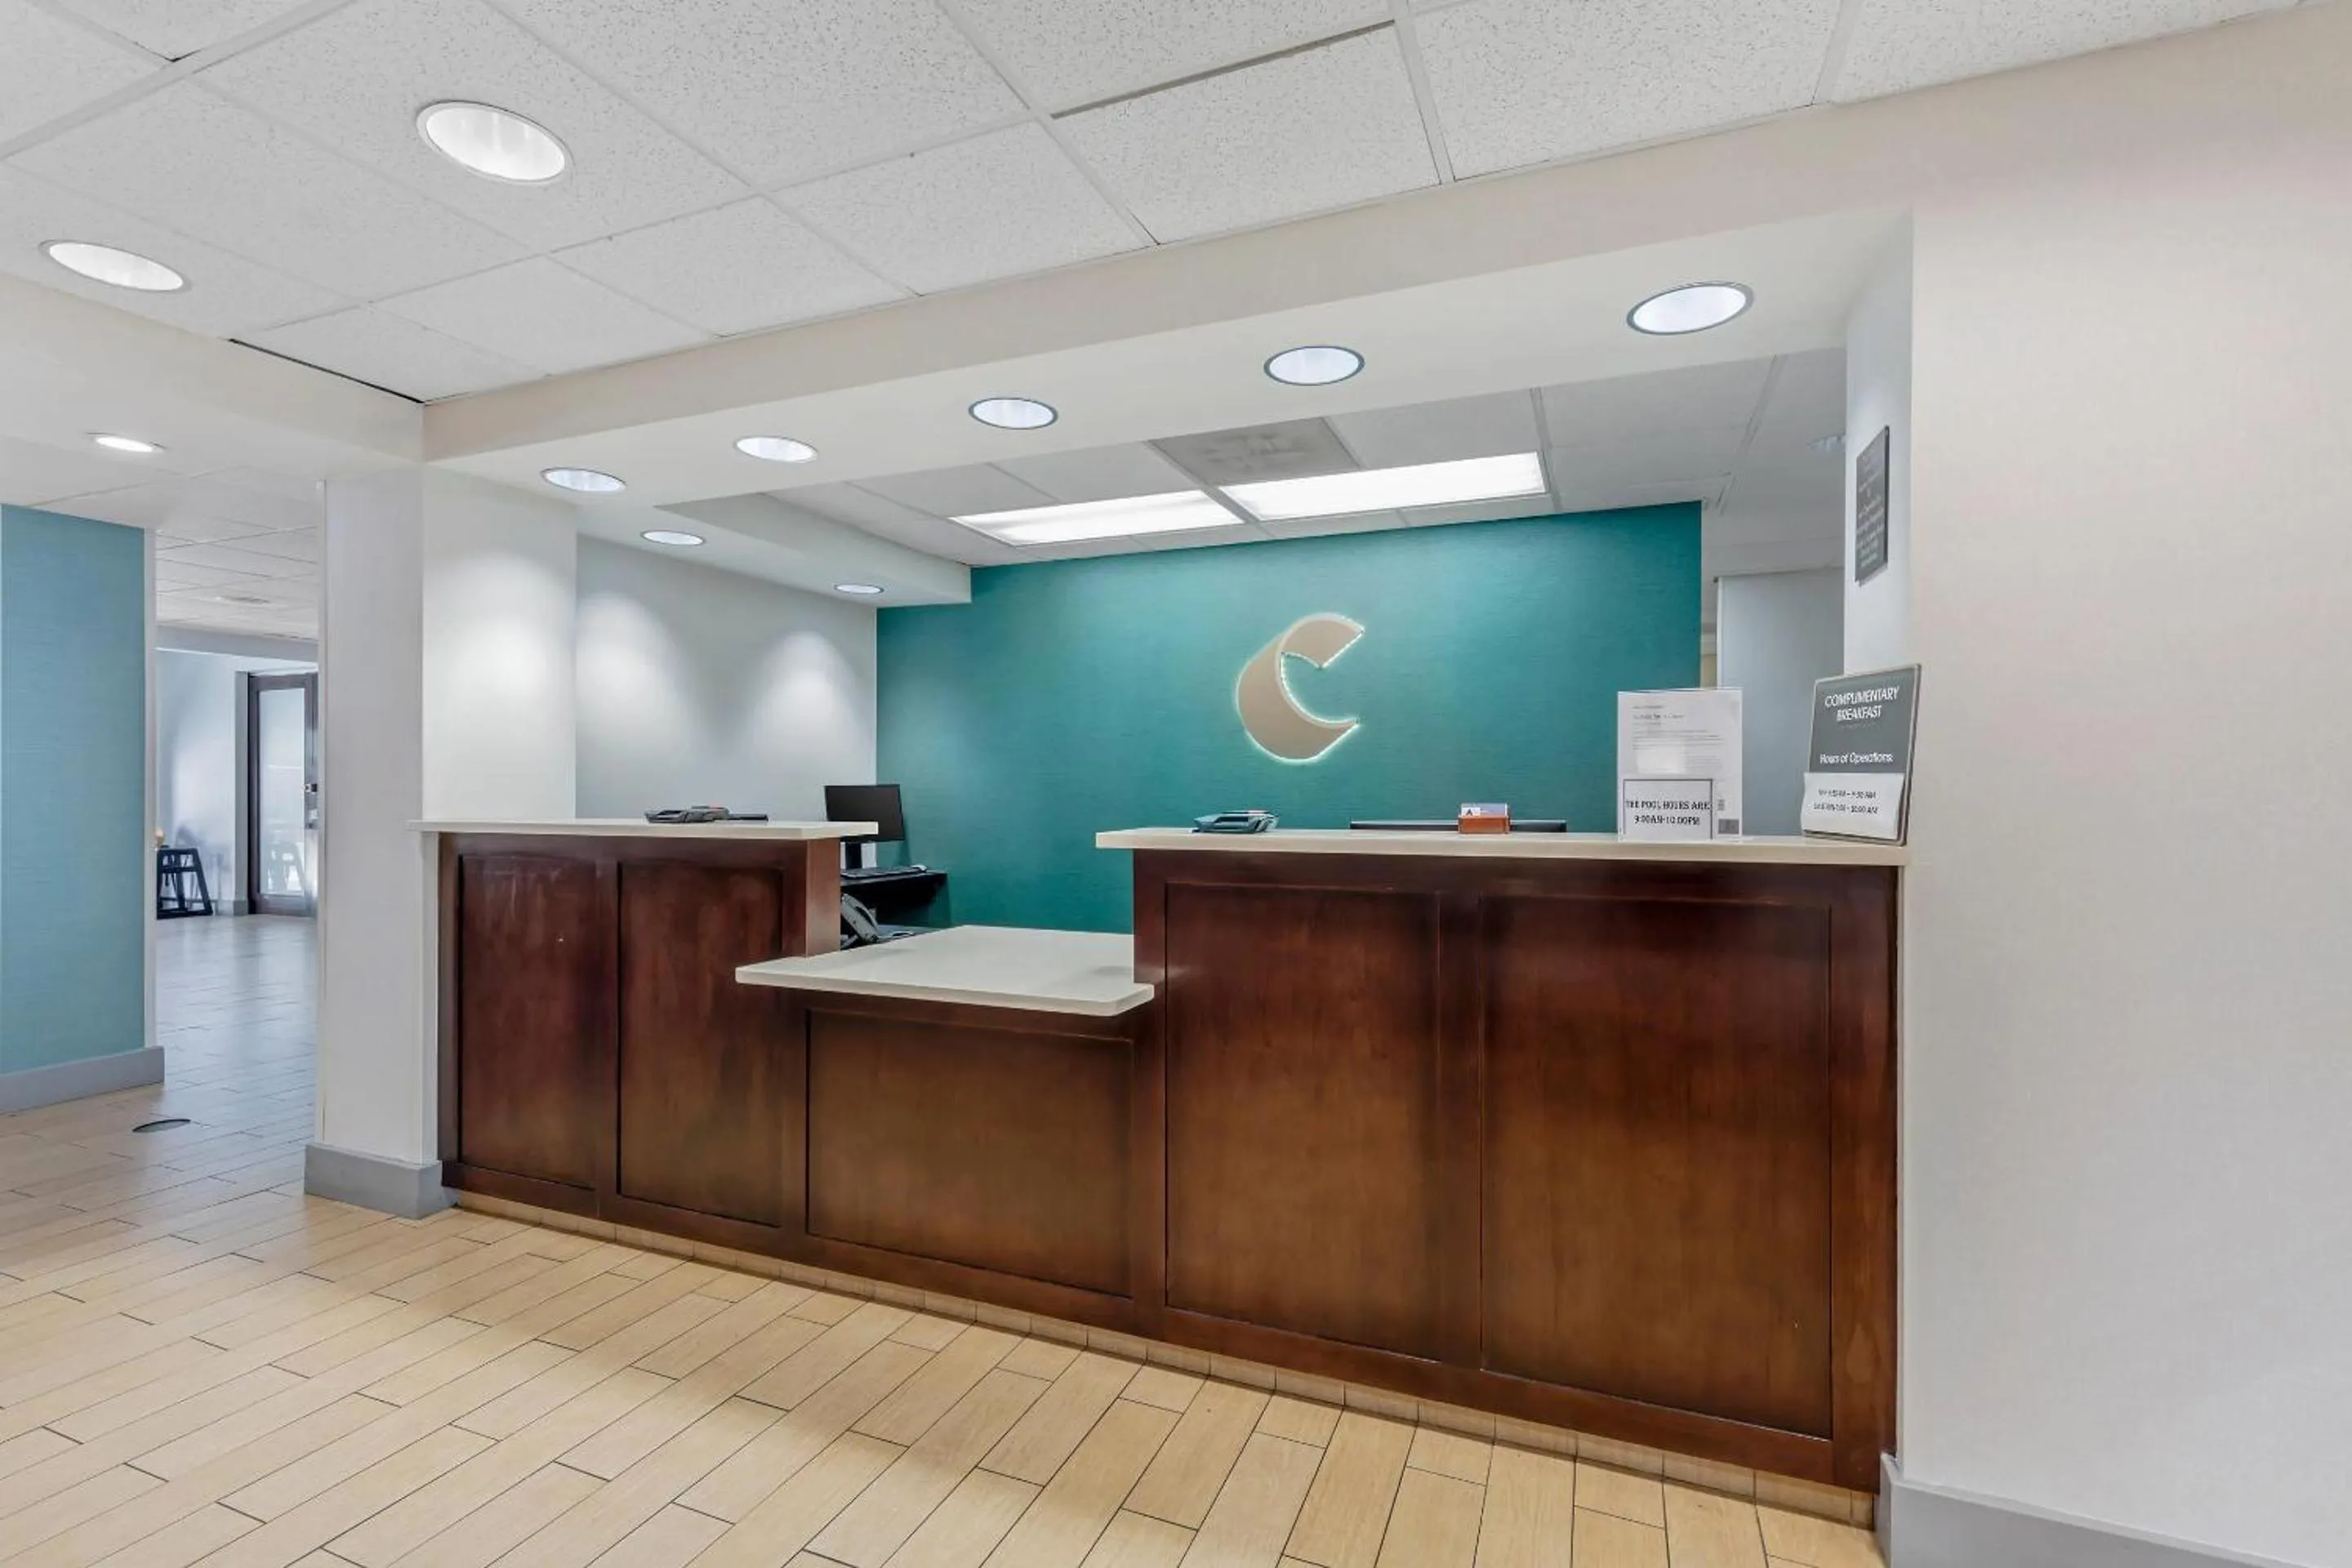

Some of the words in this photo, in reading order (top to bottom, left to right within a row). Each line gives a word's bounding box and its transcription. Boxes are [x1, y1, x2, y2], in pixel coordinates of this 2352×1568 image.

[1824, 686, 1900, 708] COMPLIMENTARY
[1837, 705, 1882, 722] BREAKFAST
[1820, 754, 1839, 764] Hours
[1840, 753, 1848, 764] of
[1641, 800, 1662, 809] POOL
[1663, 800, 1690, 810] HOURS
